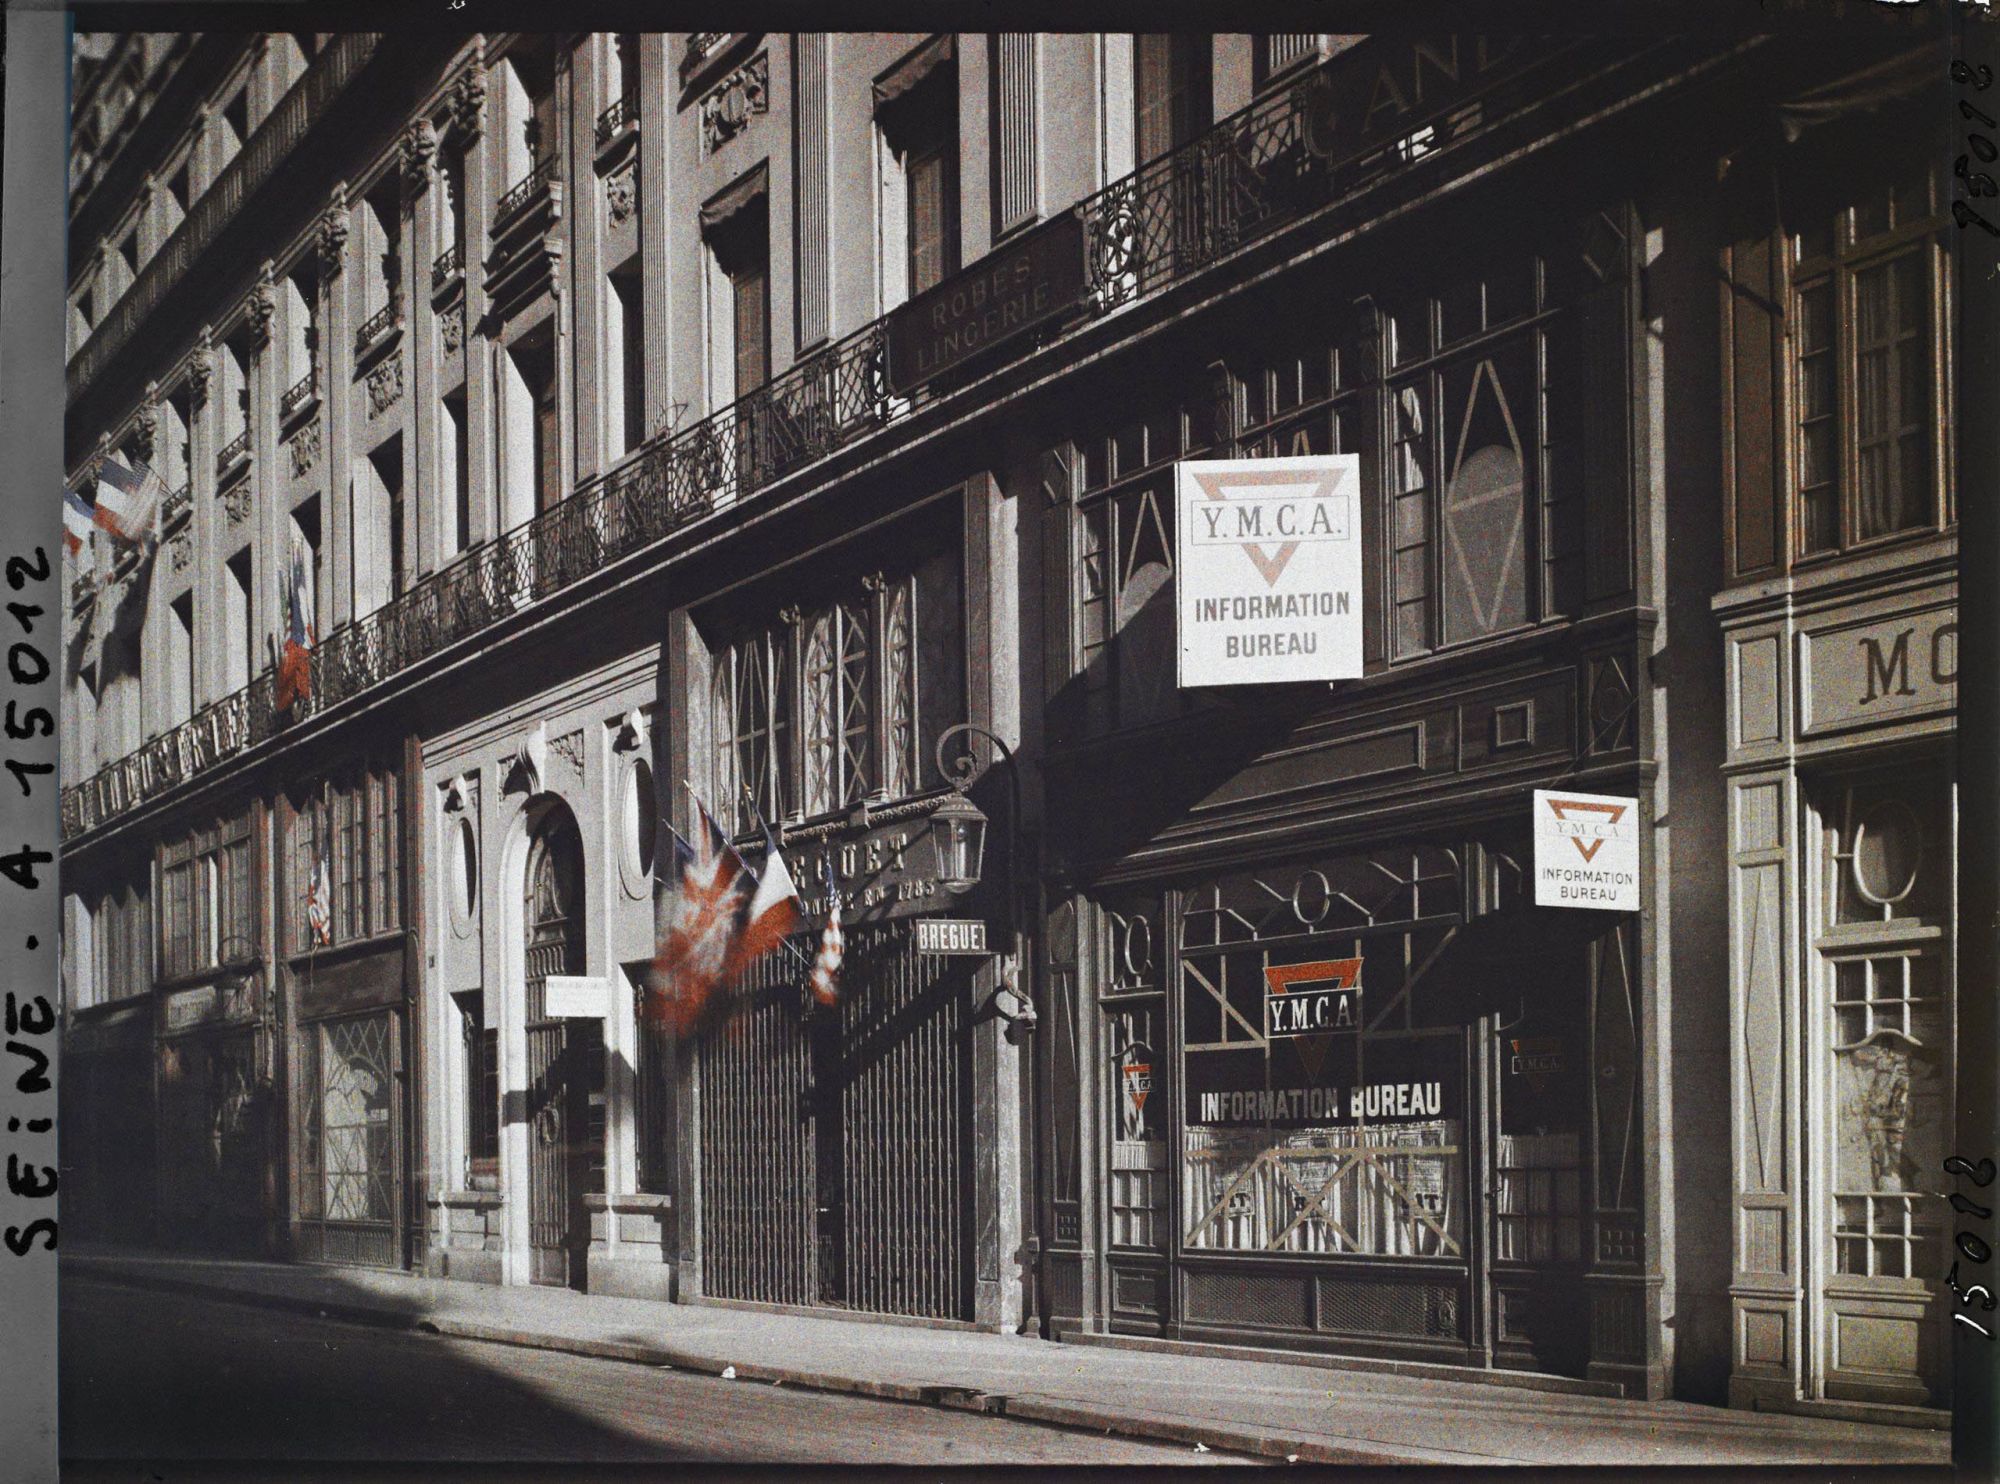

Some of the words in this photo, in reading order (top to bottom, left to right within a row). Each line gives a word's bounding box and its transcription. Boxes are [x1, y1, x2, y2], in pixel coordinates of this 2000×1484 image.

[1951, 60, 2000, 238] 15012
[932, 256, 1031, 331] ROBES
[917, 281, 1049, 372] LINGERIE
[1202, 503, 1341, 539] Y.M.C.A.
[1195, 591, 1350, 623] INFORMATION
[1226, 632, 1317, 659] BUREAU
[5, 547, 55, 797] 15012
[1542, 867, 1634, 886] INFORMATION
[1560, 885, 1618, 901] BUREAU
[1201, 1086, 1339, 1122] INFORMATION
[1350, 1082, 1441, 1118] BUREAU
[1943, 1156, 1997, 1341] 15012
